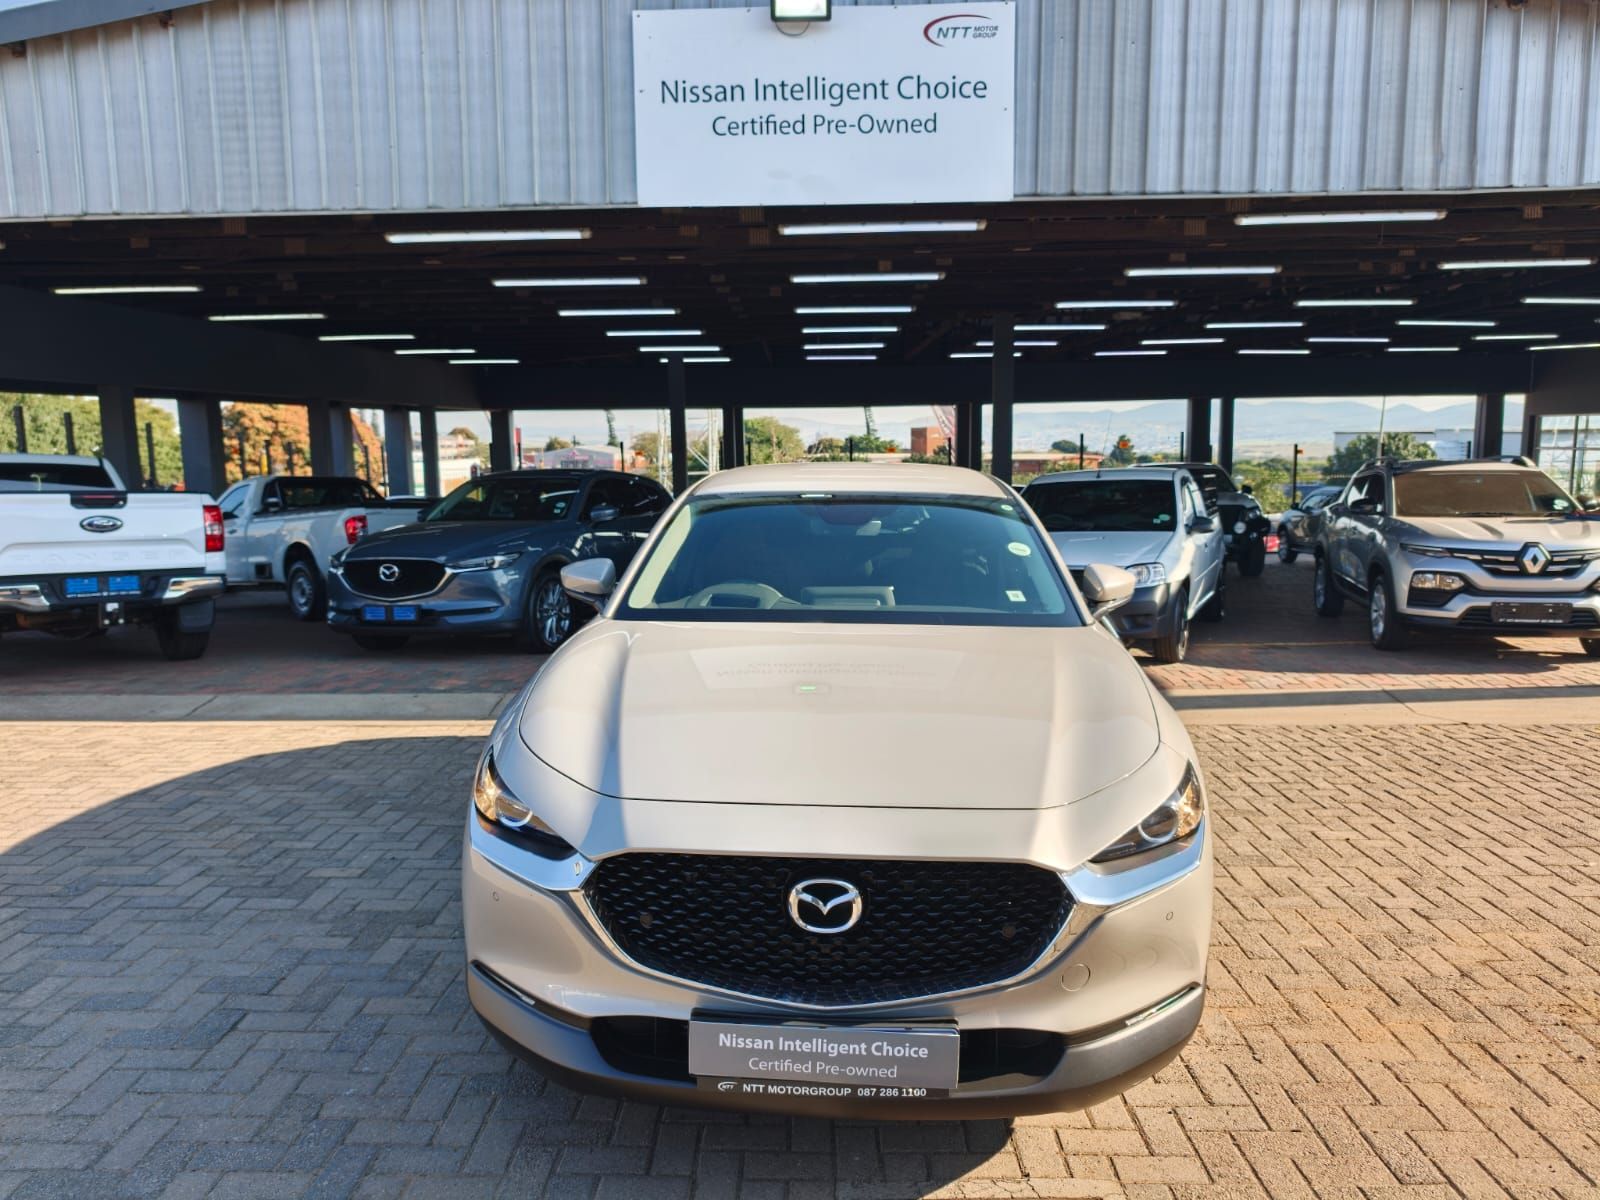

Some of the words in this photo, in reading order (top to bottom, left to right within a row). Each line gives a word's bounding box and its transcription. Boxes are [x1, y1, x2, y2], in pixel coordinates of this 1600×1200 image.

[936, 26, 972, 39] NTT
[660, 80, 745, 104] Nissan
[754, 76, 889, 106] Intelligent
[897, 75, 988, 100] Choice
[712, 114, 805, 136] Certified
[813, 112, 937, 135] Pre-Owned
[719, 1033, 774, 1050] Nissan
[779, 1036, 867, 1057] Intelligent
[871, 1041, 929, 1058] Choice
[748, 1057, 812, 1073] Certified
[816, 1061, 898, 1078] Pre-owned
[743, 1083, 765, 1093] NTT
[768, 1084, 851, 1097] MOTORGROUP
[857, 1088, 876, 1097] 087
[879, 1088, 899, 1097] 286
[901, 1088, 927, 1097] 1100
